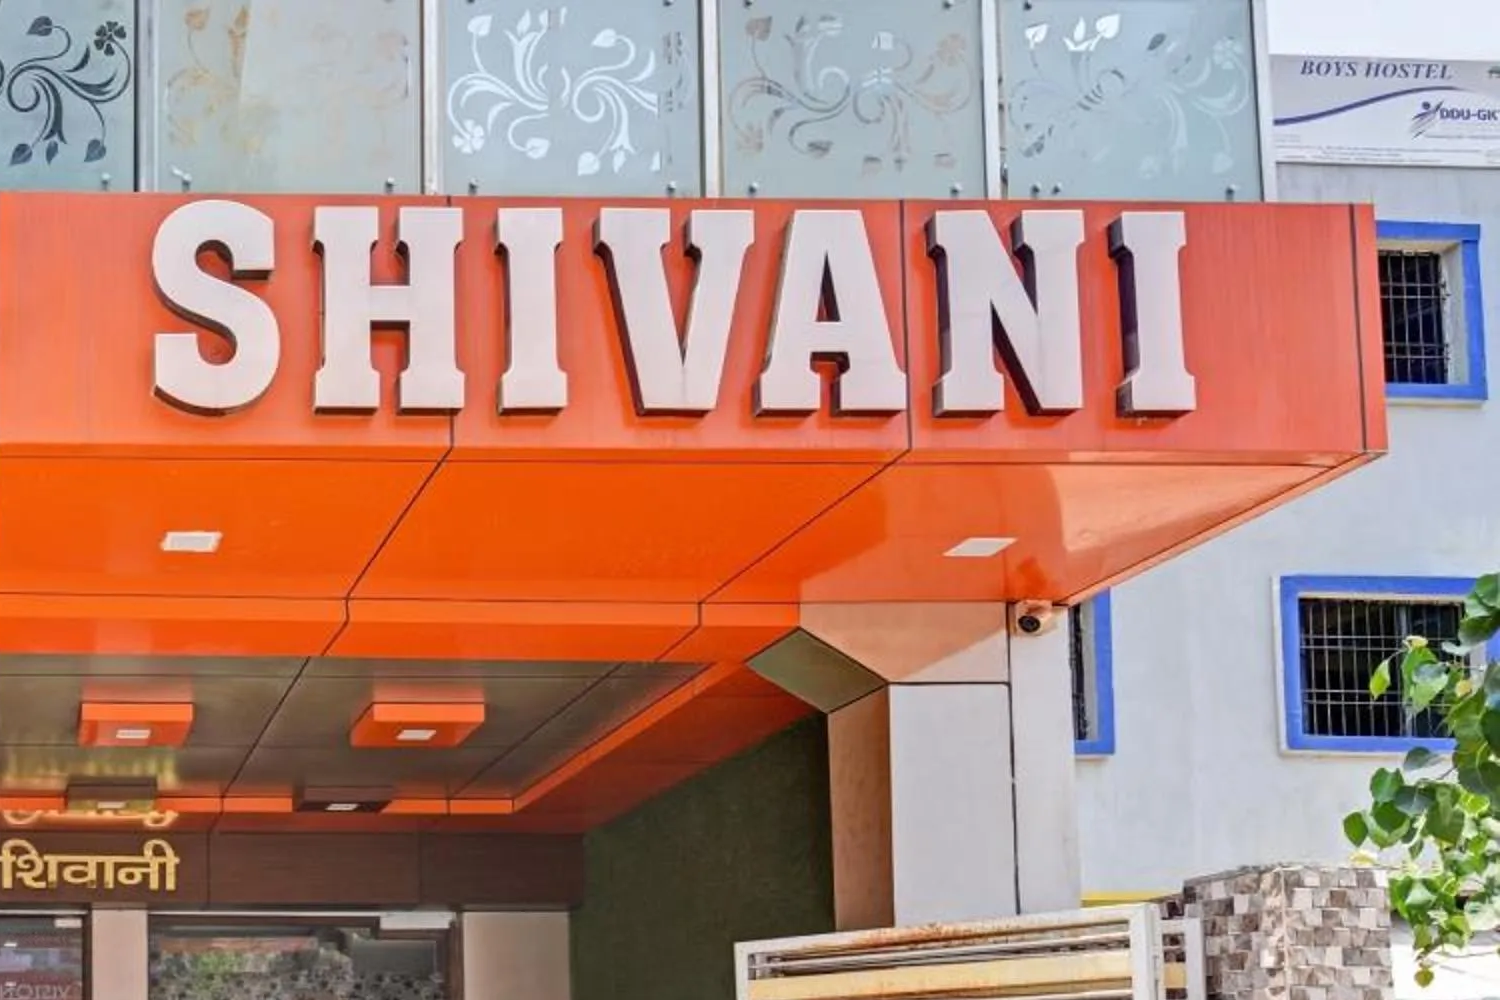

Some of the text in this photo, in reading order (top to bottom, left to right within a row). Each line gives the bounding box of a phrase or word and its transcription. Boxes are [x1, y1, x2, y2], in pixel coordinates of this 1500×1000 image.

[1300, 59, 1453, 79] BOYS HOSTEL
[1439, 107, 1500, 121] DDU-GK
[152, 198, 1197, 415] SHIVANI
